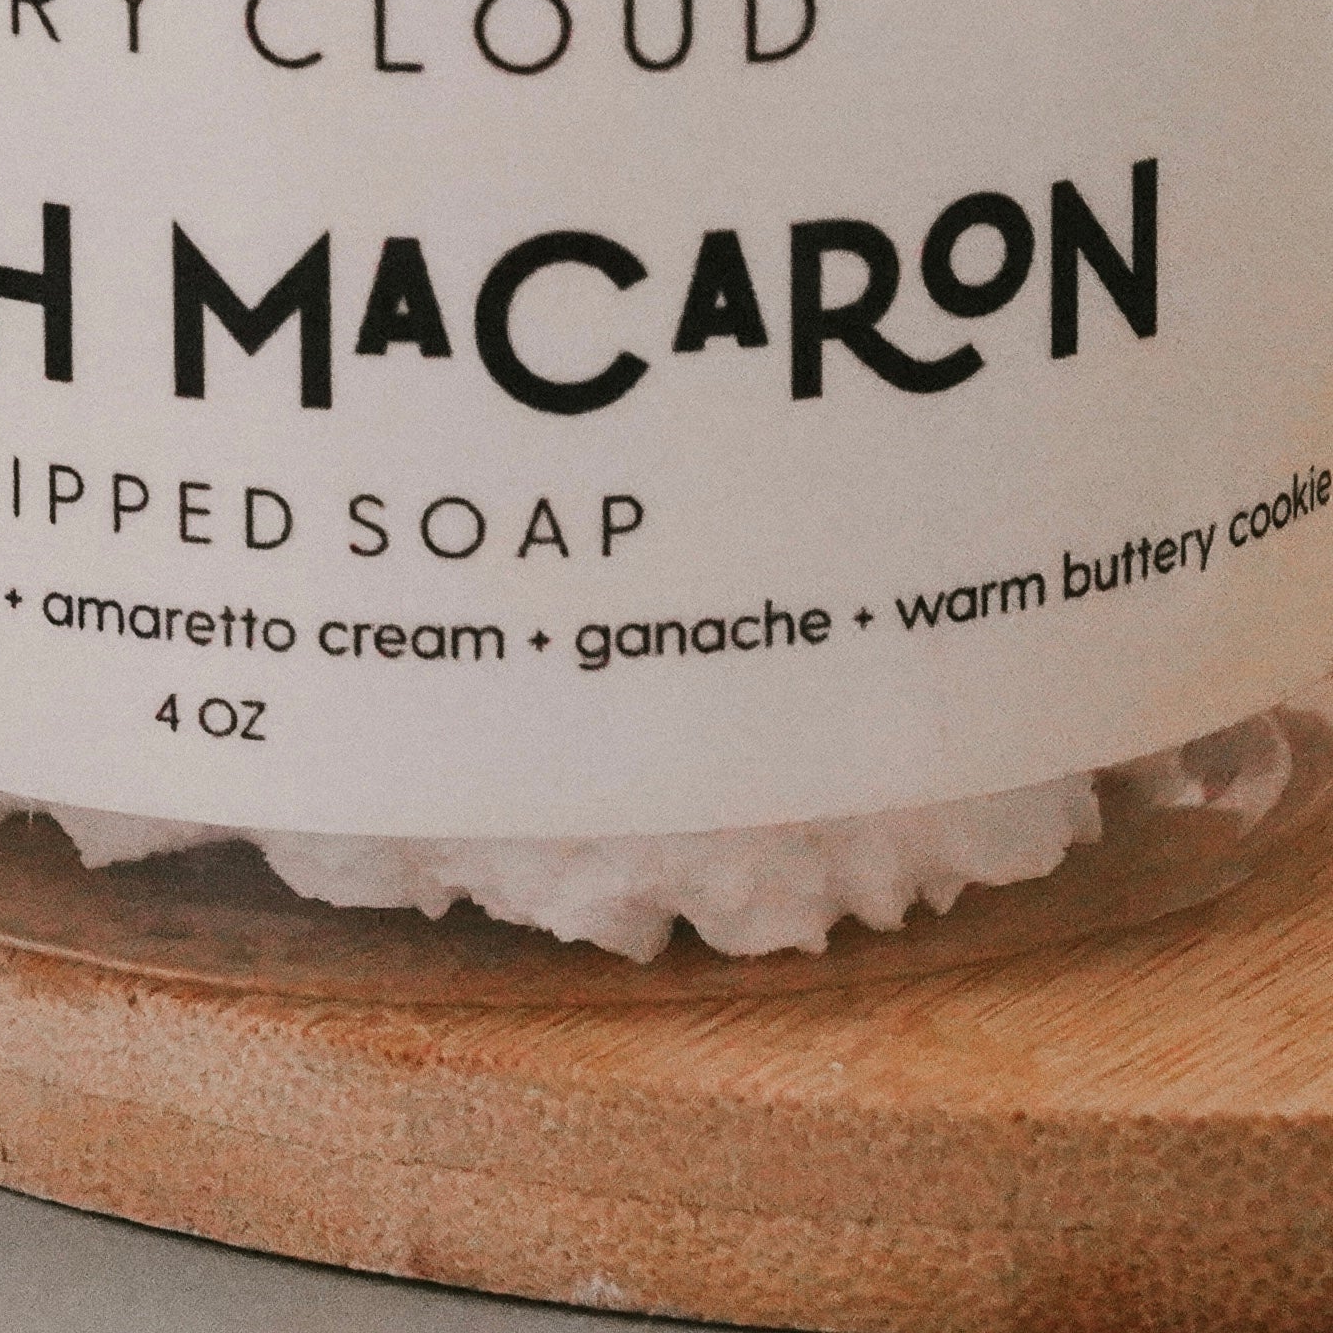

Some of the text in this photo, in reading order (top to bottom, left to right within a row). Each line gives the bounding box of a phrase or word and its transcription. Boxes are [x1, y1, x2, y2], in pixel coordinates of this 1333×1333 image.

[171, 157, 1159, 417] MACARON
[42, 591, 297, 653] amaretto
[317, 620, 506, 661] cream
[574, 599, 832, 672] ganache
[895, 572, 1047, 631] warm
[1062, 523, 1216, 601] buttery
[1228, 464, 1333, 548] cookie
[348, 493, 645, 561] SOAP
[155, 693, 267, 742] 4 OZ
